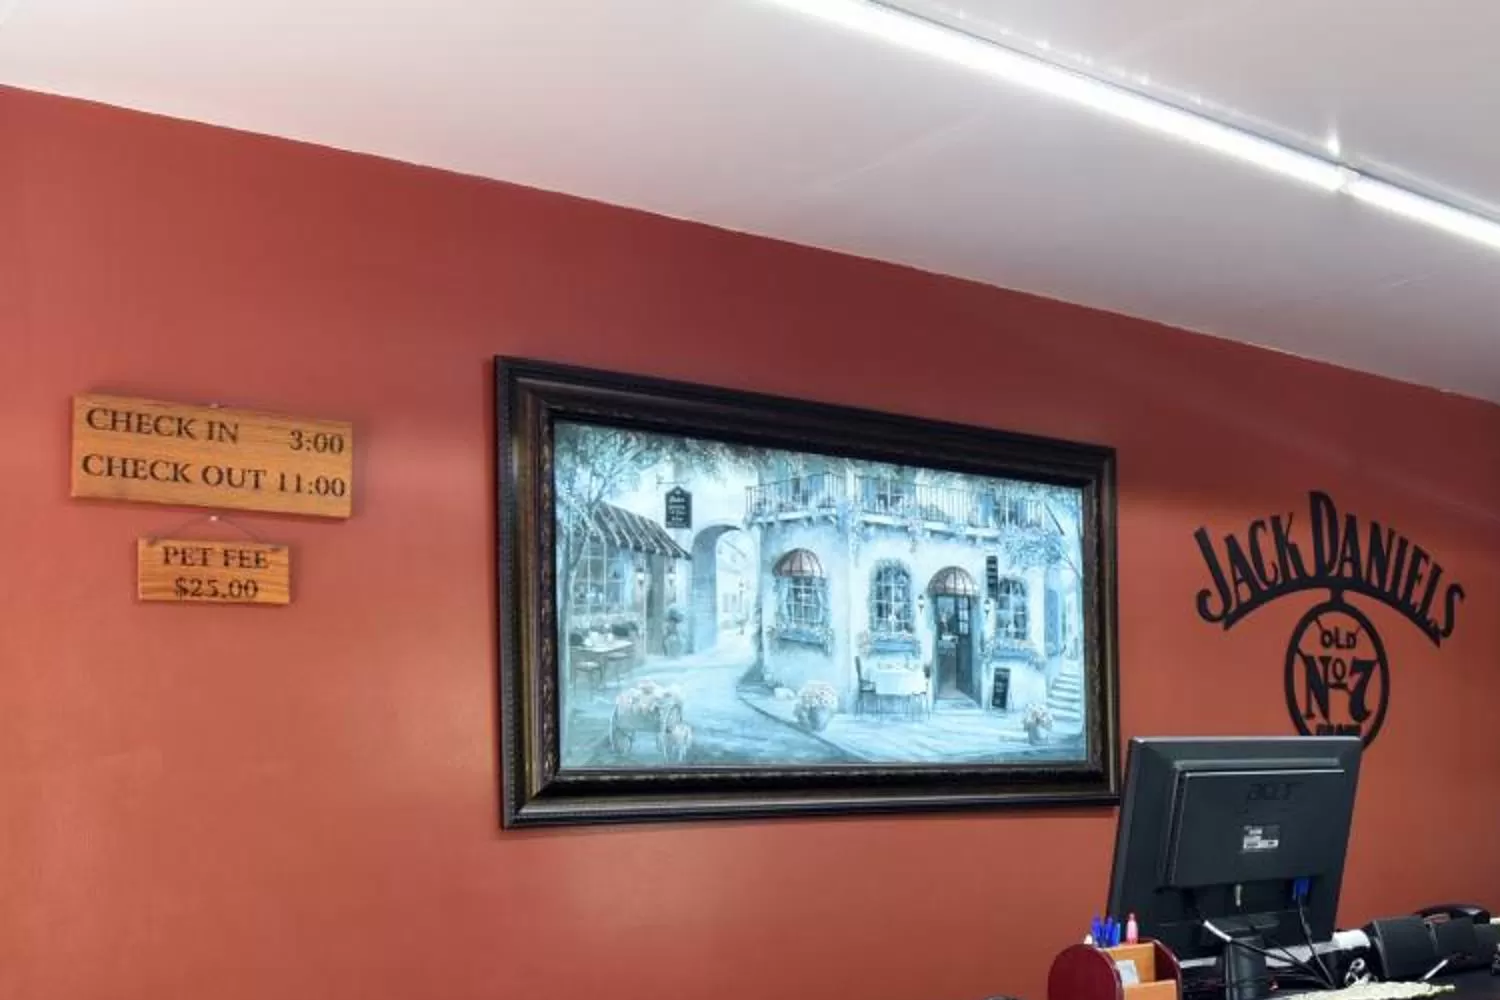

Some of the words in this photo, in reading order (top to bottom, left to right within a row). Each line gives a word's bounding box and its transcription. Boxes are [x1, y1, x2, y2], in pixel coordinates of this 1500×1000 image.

[85, 407, 198, 440] CHECK
[206, 420, 240, 444] IN
[289, 429, 344, 455] 3:00
[80, 453, 191, 484] CHECK
[200, 464, 267, 492] OUT
[278, 472, 346, 498] 11:00
[162, 546, 214, 567] PET
[221, 549, 269, 569] FEE
[1193, 512, 1308, 624] JACK
[1308, 490, 1466, 639] DANIELS
[174, 576, 259, 600] $25.00
[1319, 629, 1358, 650] OLD
